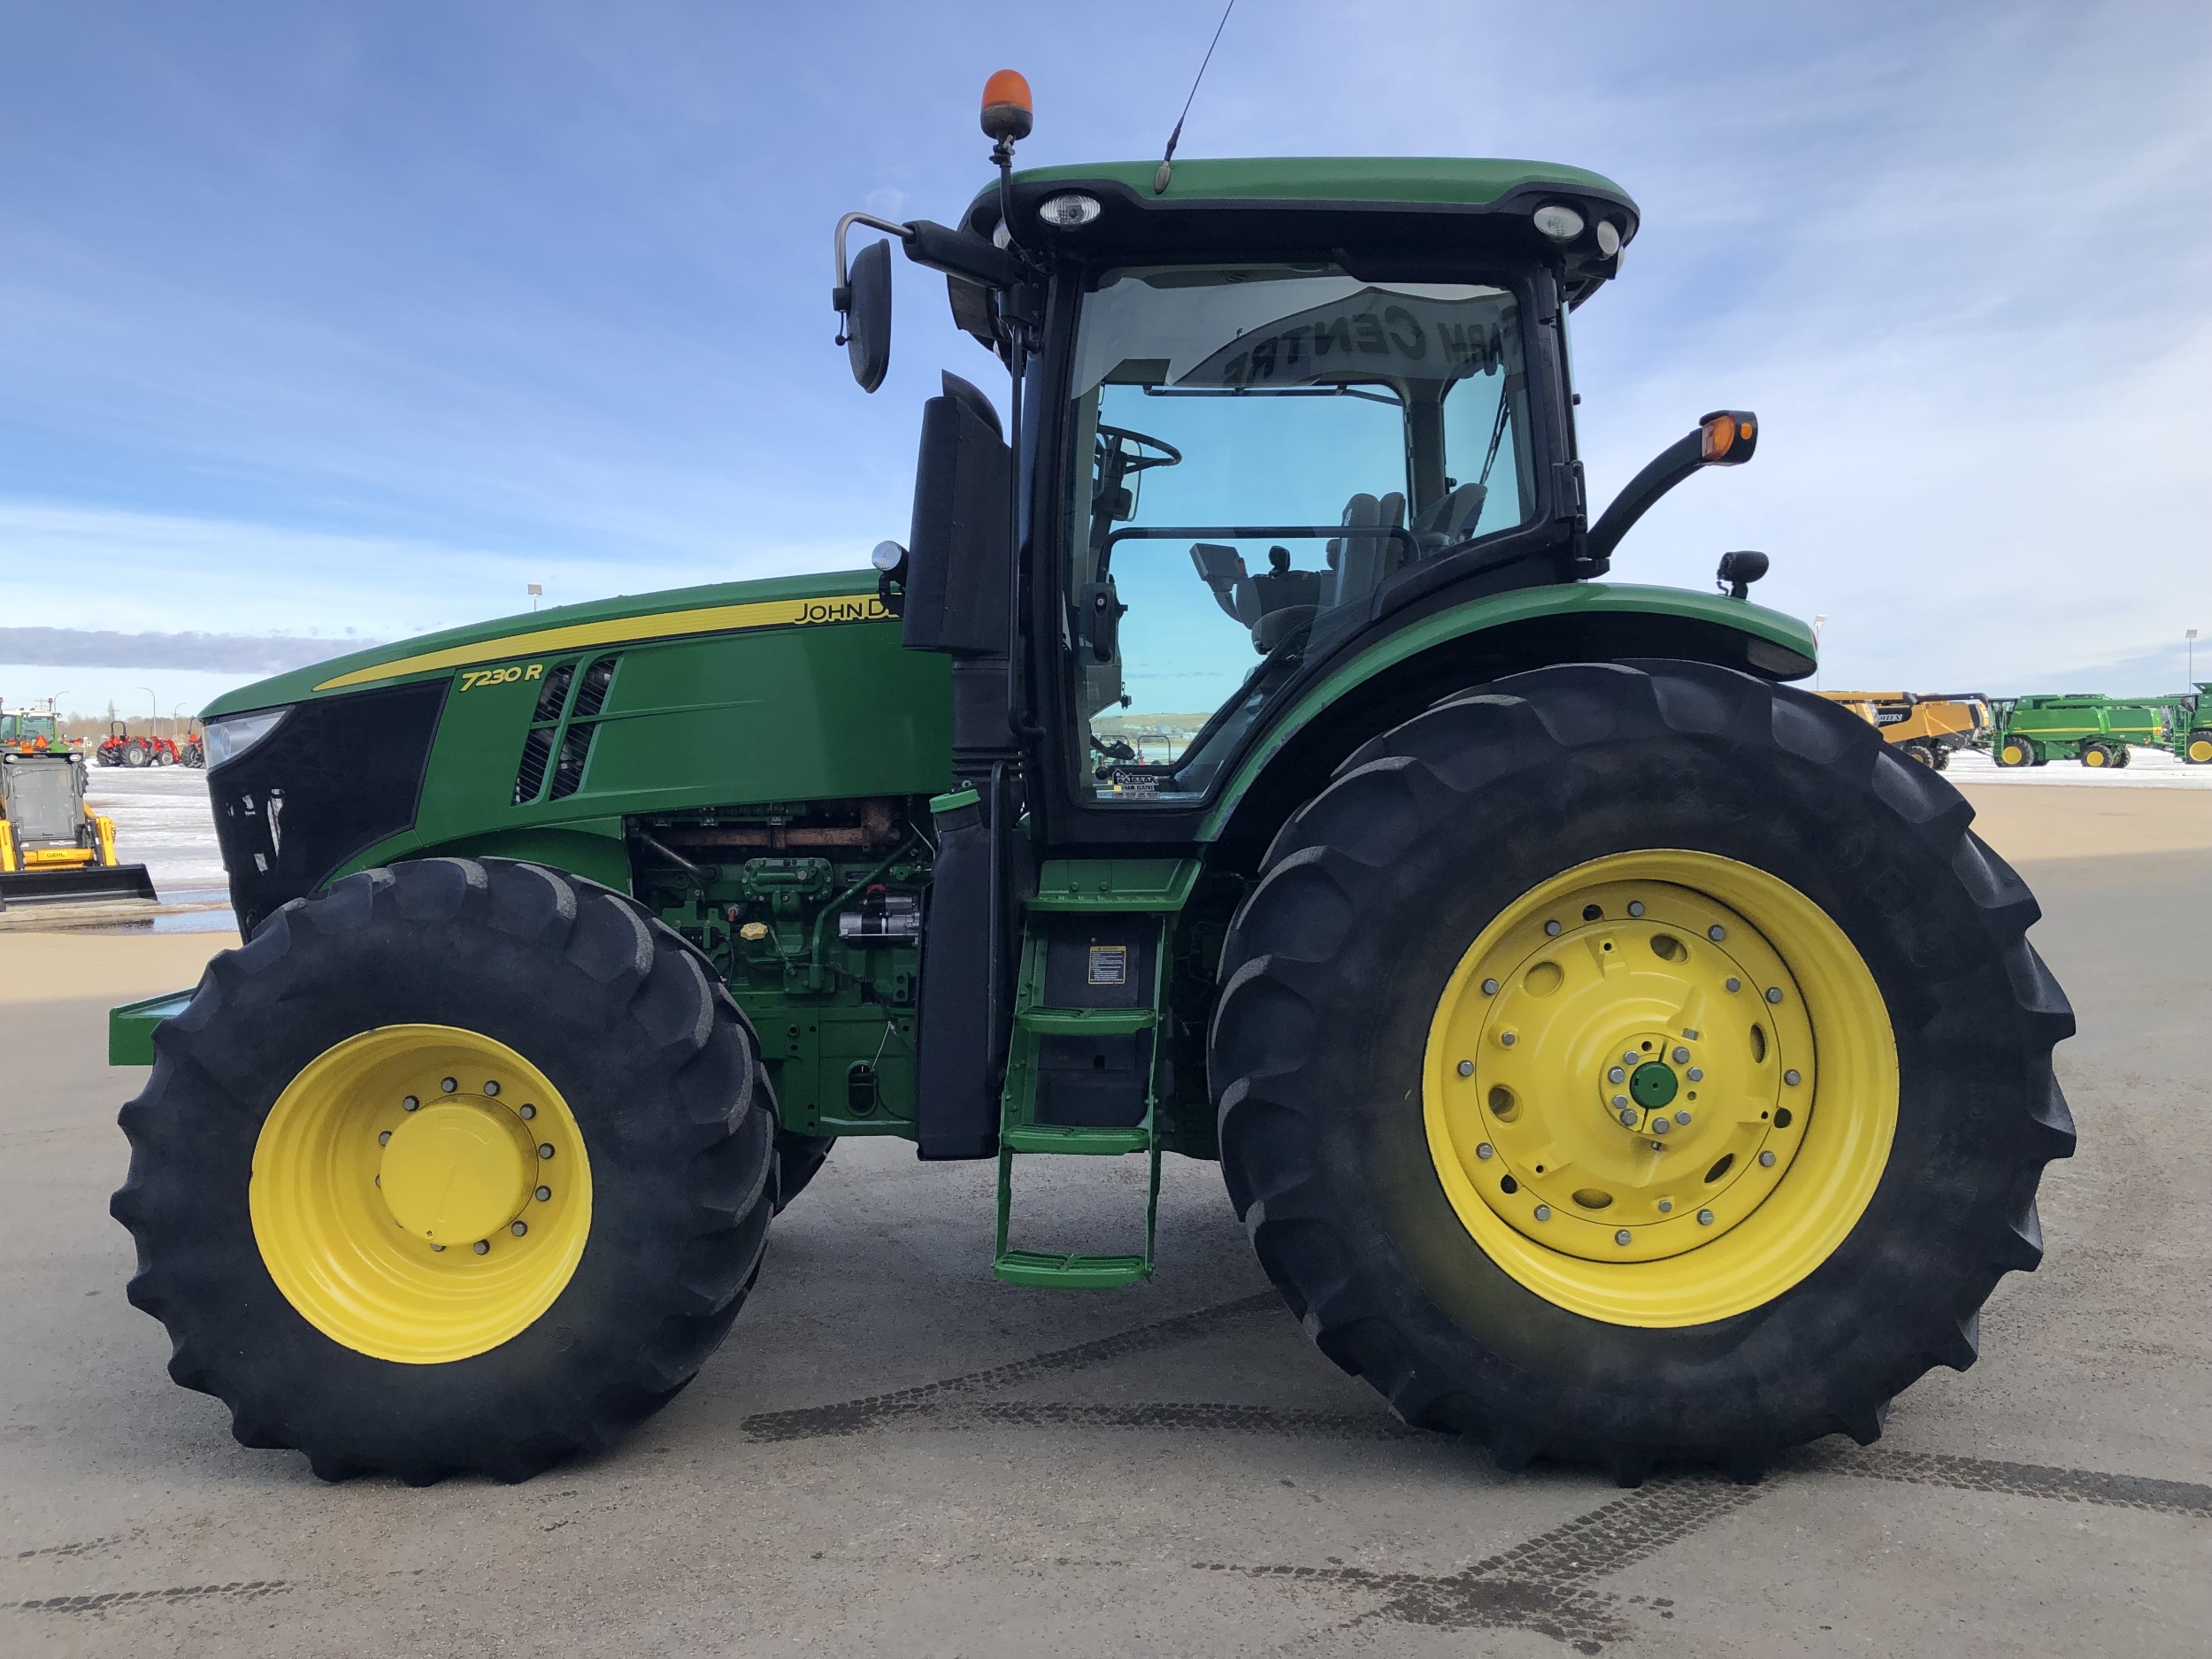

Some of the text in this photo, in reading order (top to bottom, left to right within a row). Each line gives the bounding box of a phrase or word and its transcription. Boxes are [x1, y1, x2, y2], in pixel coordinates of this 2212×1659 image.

[795, 603, 862, 621] JOHN
[459, 664, 543, 692] 7230 R
